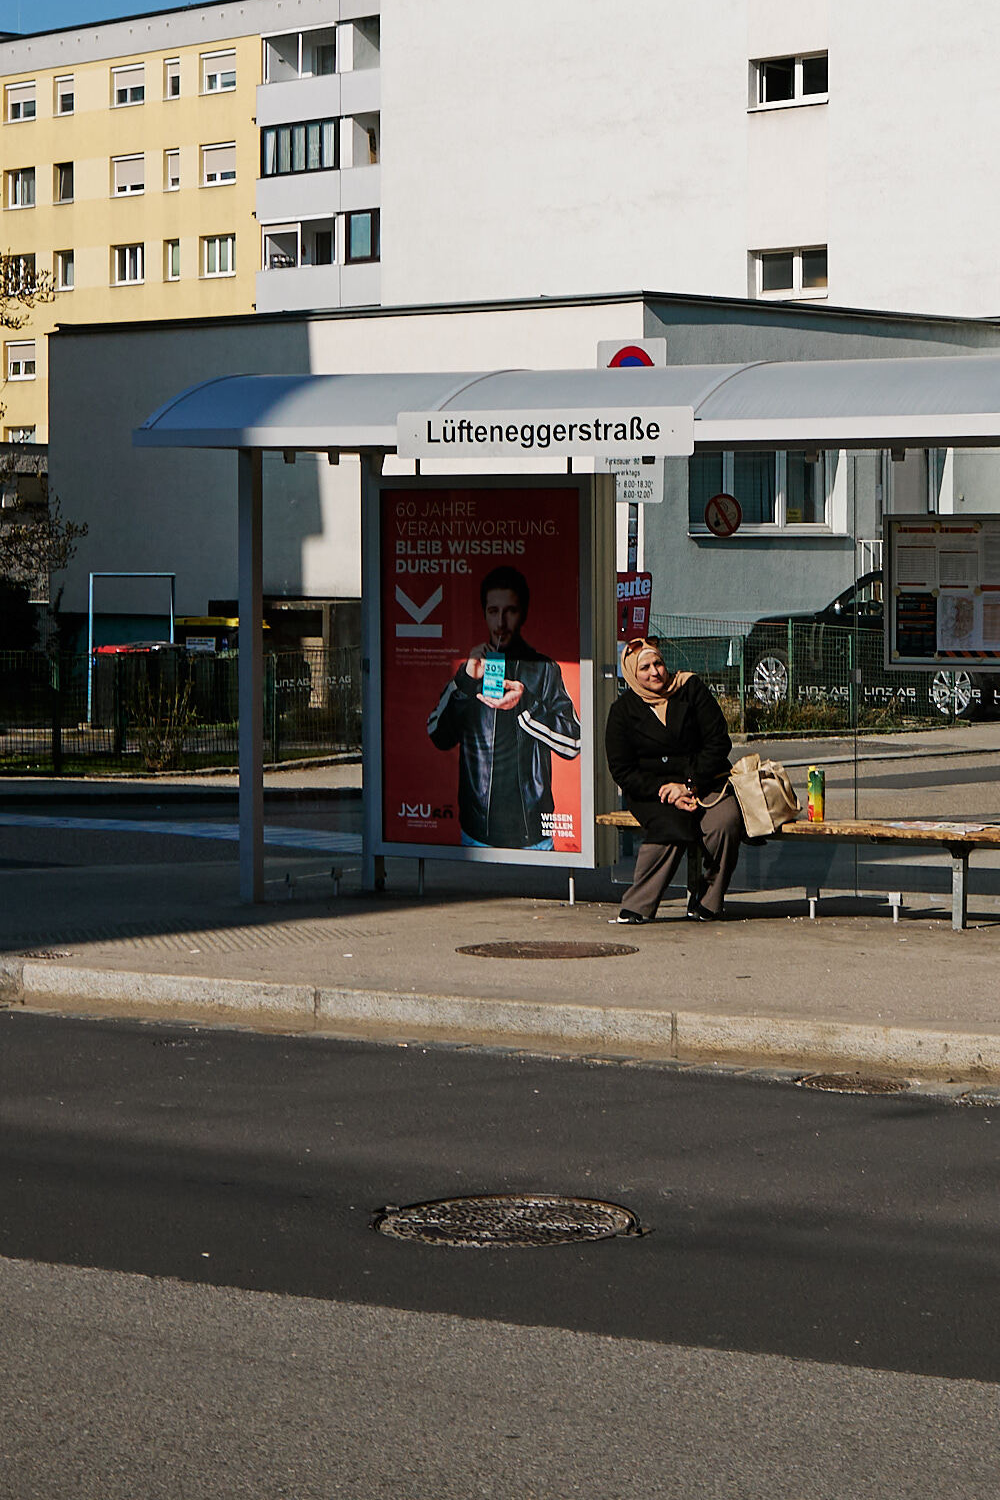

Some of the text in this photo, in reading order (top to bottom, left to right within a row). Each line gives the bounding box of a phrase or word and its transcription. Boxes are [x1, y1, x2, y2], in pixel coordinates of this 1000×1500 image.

[427, 416, 660, 448] Lüfteneggerstraße
[396, 501, 476, 517] 60 JAHRE
[396, 520, 560, 537] VERANTWORTUNG.
[395, 540, 526, 555] BLEIB WISSENS
[395, 559, 472, 574] DURSTIG.
[830, 686, 849, 695] AG
[864, 687, 916, 696] LINZ AG
[541, 813, 572, 821] WISSEN
[541, 821, 573, 830] WOLLEN
[542, 829, 556, 837] SEIT
